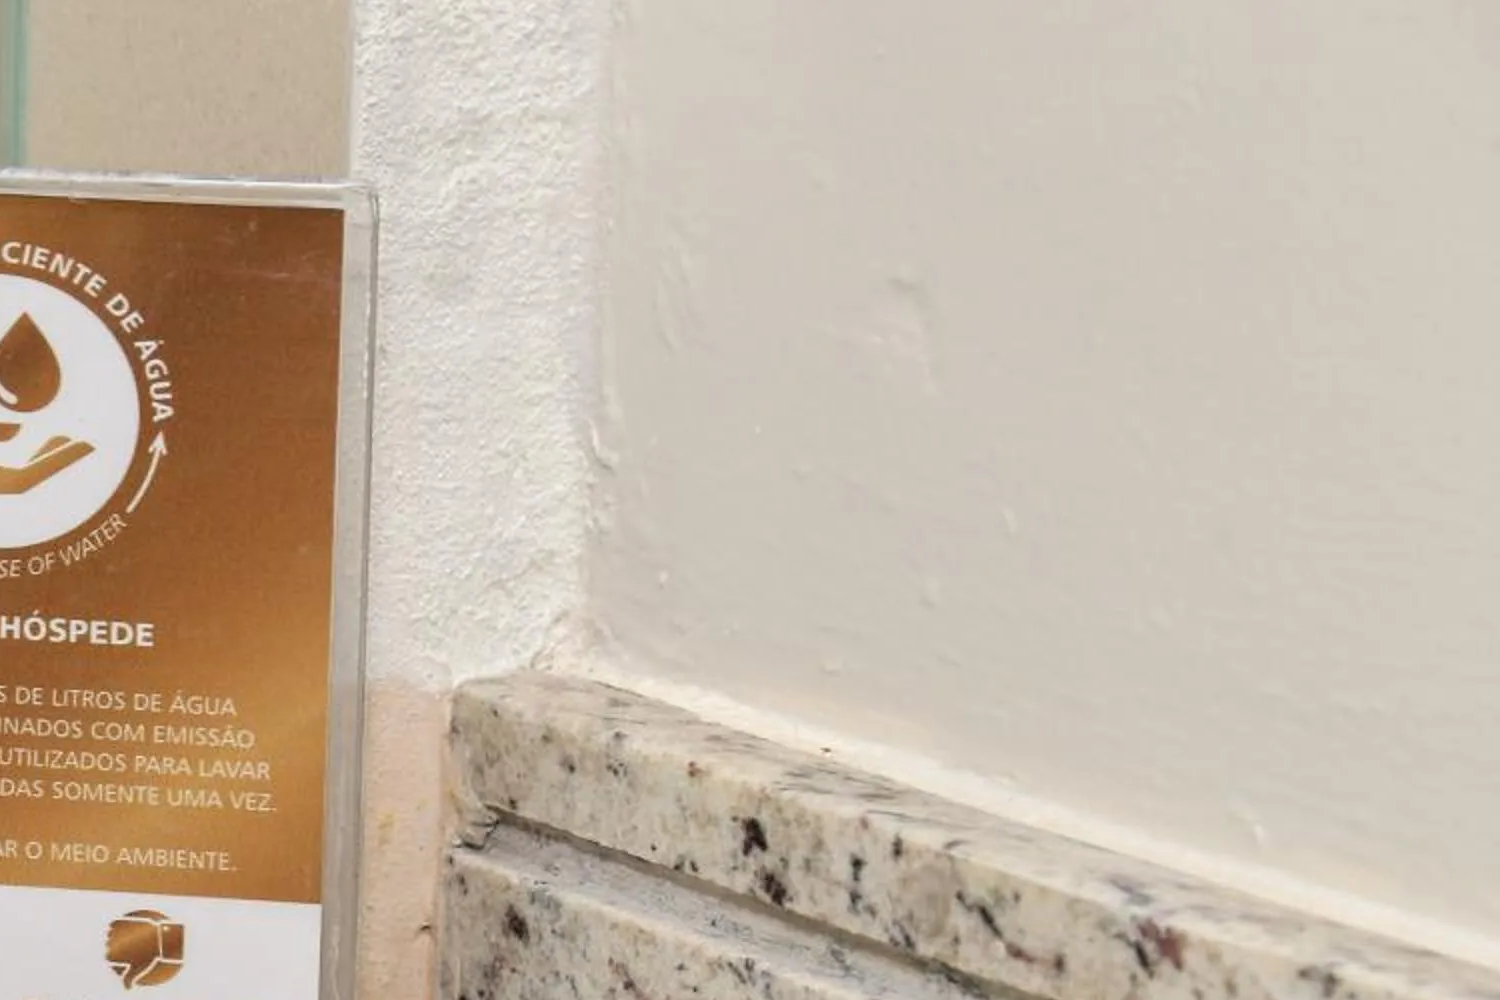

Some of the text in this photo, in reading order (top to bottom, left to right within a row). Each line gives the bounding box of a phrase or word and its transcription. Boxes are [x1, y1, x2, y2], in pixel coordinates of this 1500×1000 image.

[105, 293, 145, 333] DE
[134, 339, 175, 423] ÁGUA
[27, 552, 56, 576] OF
[58, 513, 128, 567] WATER
[0, 609, 155, 648] HÓSPEDE
[15, 686, 44, 706] DE
[52, 688, 126, 712] LITROS
[134, 693, 161, 713] DE
[169, 690, 237, 717] ÁGUA
[91, 721, 145, 743] COM
[153, 725, 256, 750] EMISSÃO
[135, 755, 192, 776] PARA
[200, 760, 271, 781] LAVAR
[52, 781, 160, 806] SOMENTE
[167, 789, 223, 810] UMA
[230, 792, 278, 812] VEZ.
[25, 841, 43, 859] O
[50, 843, 109, 864] MEIO
[115, 848, 240, 872] AMBIENTE.
